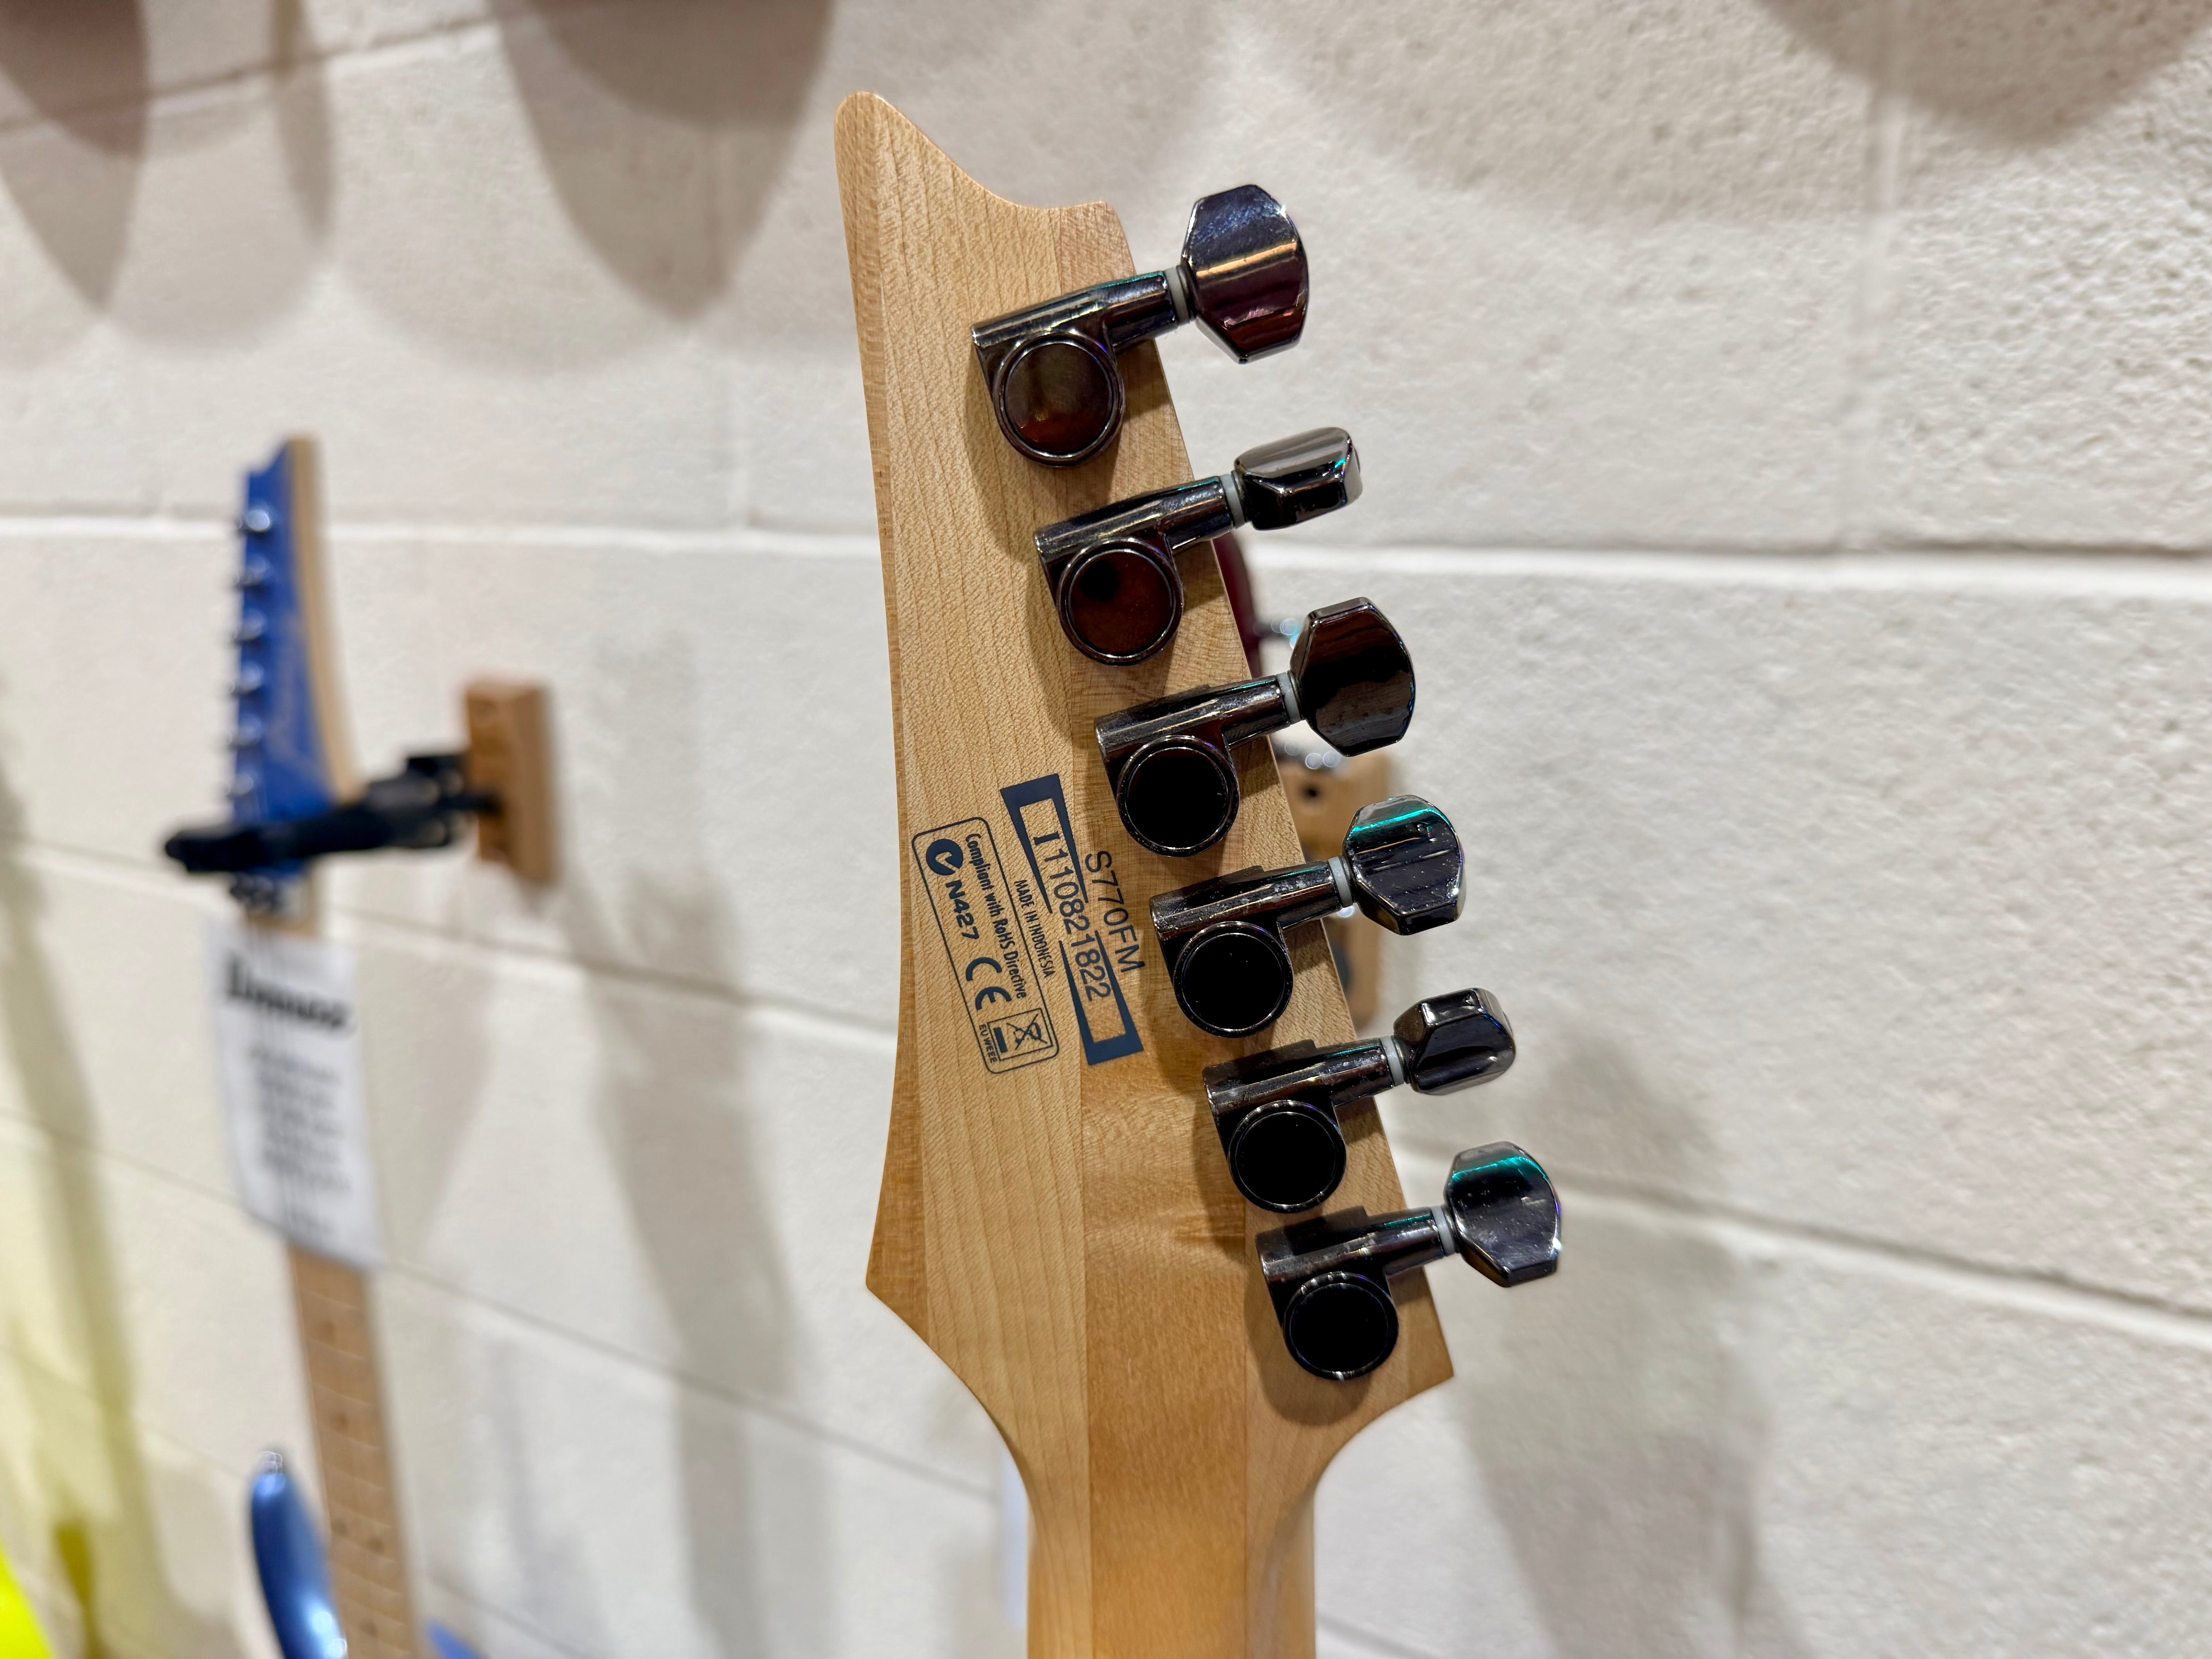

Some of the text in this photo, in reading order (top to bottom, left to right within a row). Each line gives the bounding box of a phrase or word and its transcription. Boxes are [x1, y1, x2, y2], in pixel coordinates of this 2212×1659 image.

[945, 880, 979, 940] N427
[965, 833, 1027, 999] Compliant with RoHS Directive
[1014, 879, 1056, 978] MADE IN INDONESIA
[1084, 850, 1146, 974] S770FM
[979, 1024, 998, 1064] EU WEEE
